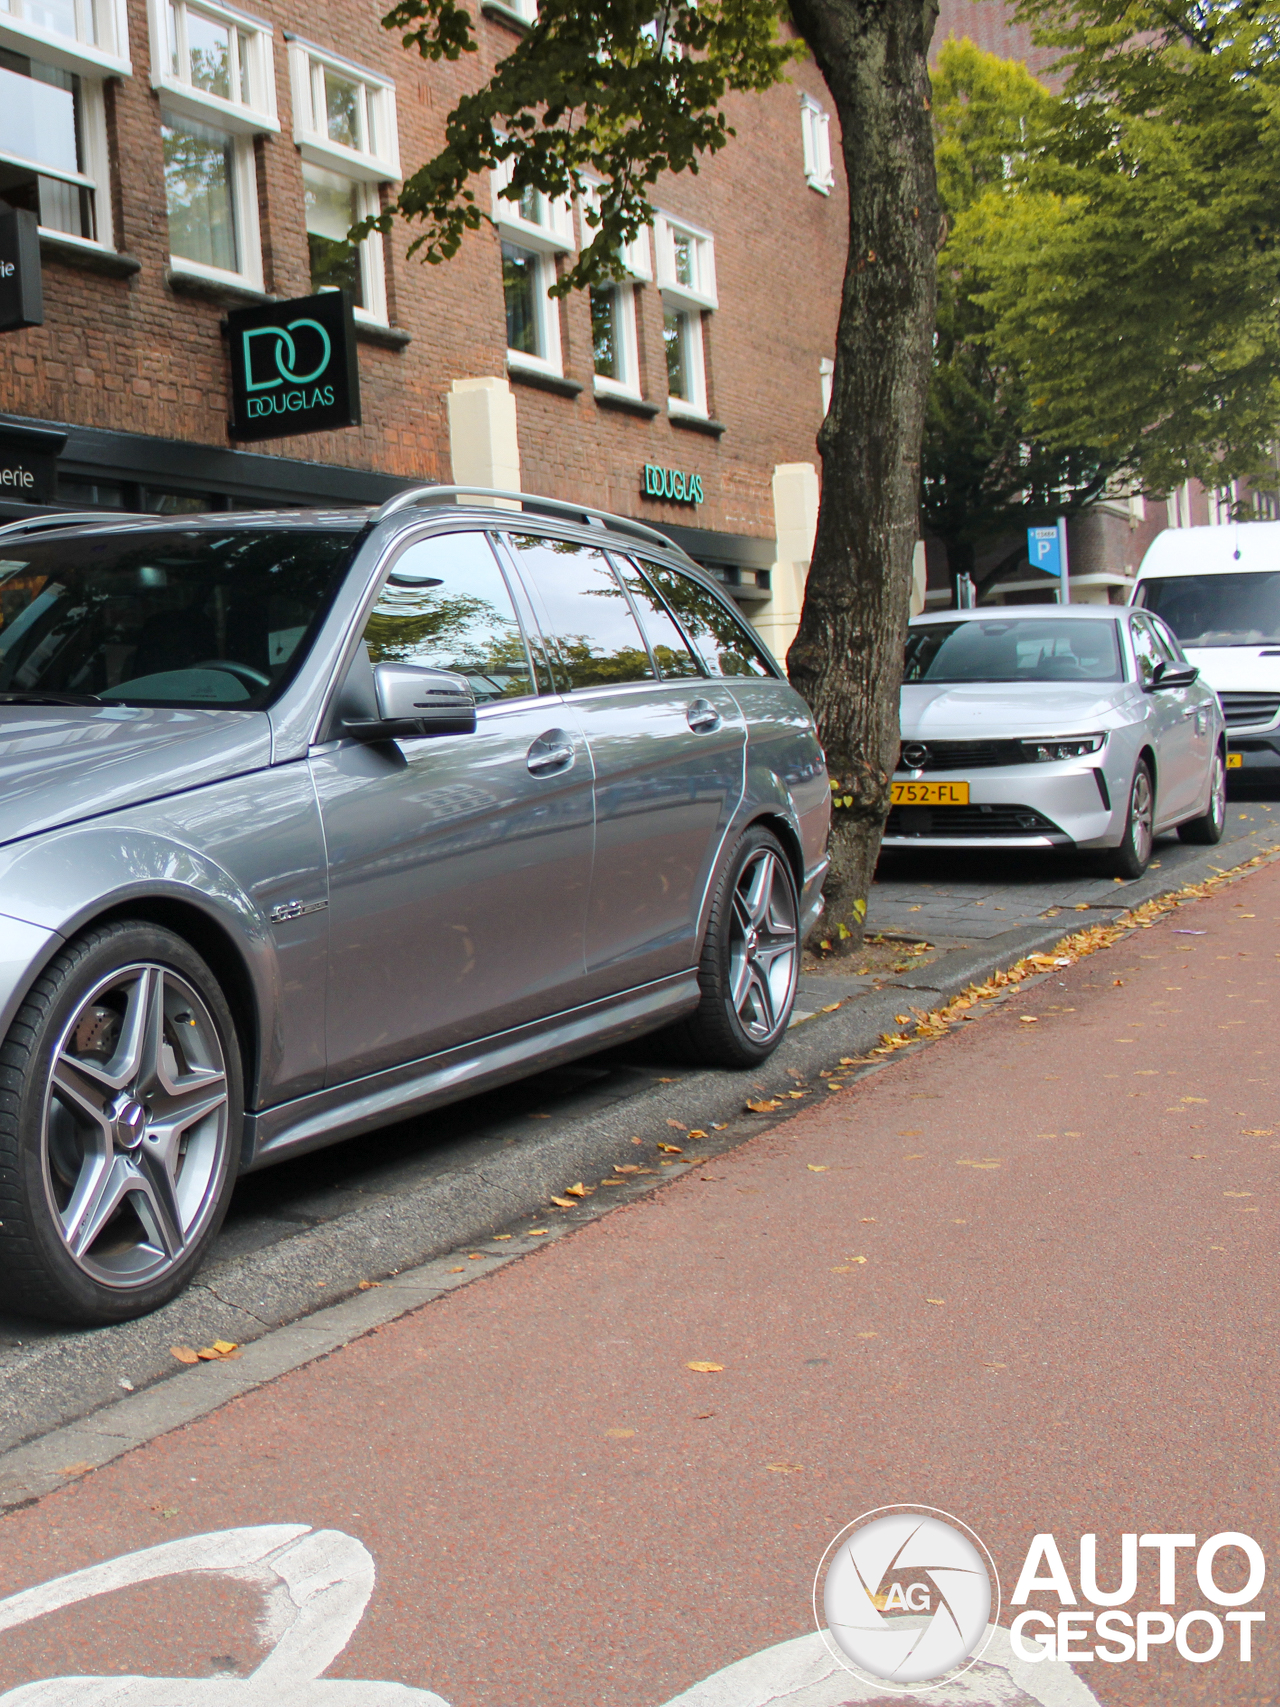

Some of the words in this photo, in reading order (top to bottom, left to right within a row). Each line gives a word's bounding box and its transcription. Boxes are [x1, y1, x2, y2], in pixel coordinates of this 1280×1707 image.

[246, 385, 335, 419] DOUGLAS
[644, 463, 704, 505] DOUGLAS
[1037, 541, 1051, 561] P
[891, 785, 960, 802] -752-FL
